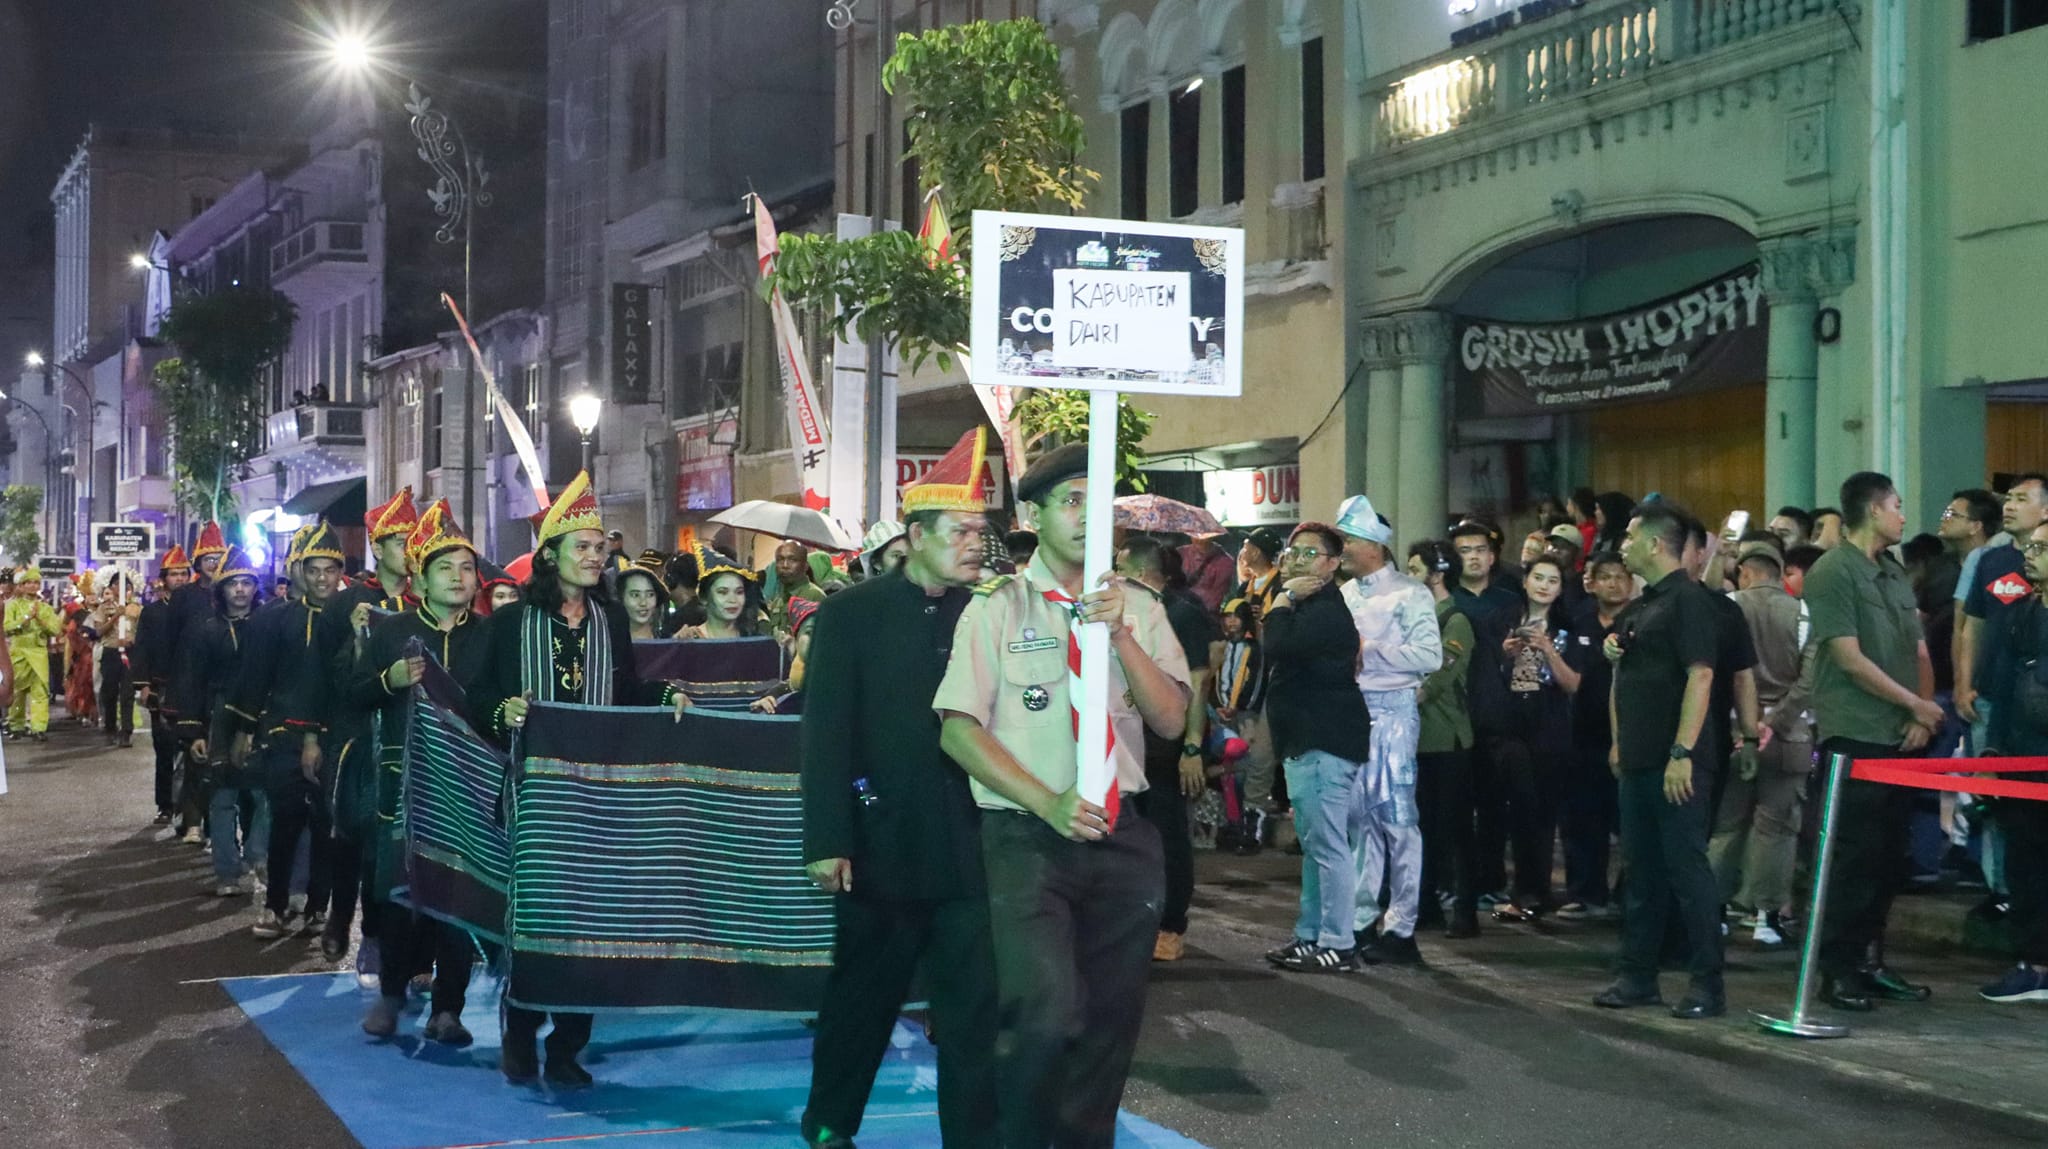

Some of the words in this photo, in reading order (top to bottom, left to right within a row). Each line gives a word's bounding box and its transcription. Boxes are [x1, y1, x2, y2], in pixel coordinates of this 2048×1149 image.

[1068, 279, 1177, 310] KABUPATEN
[623, 288, 638, 388] GALAXY
[1069, 319, 1120, 346] DAIRI
